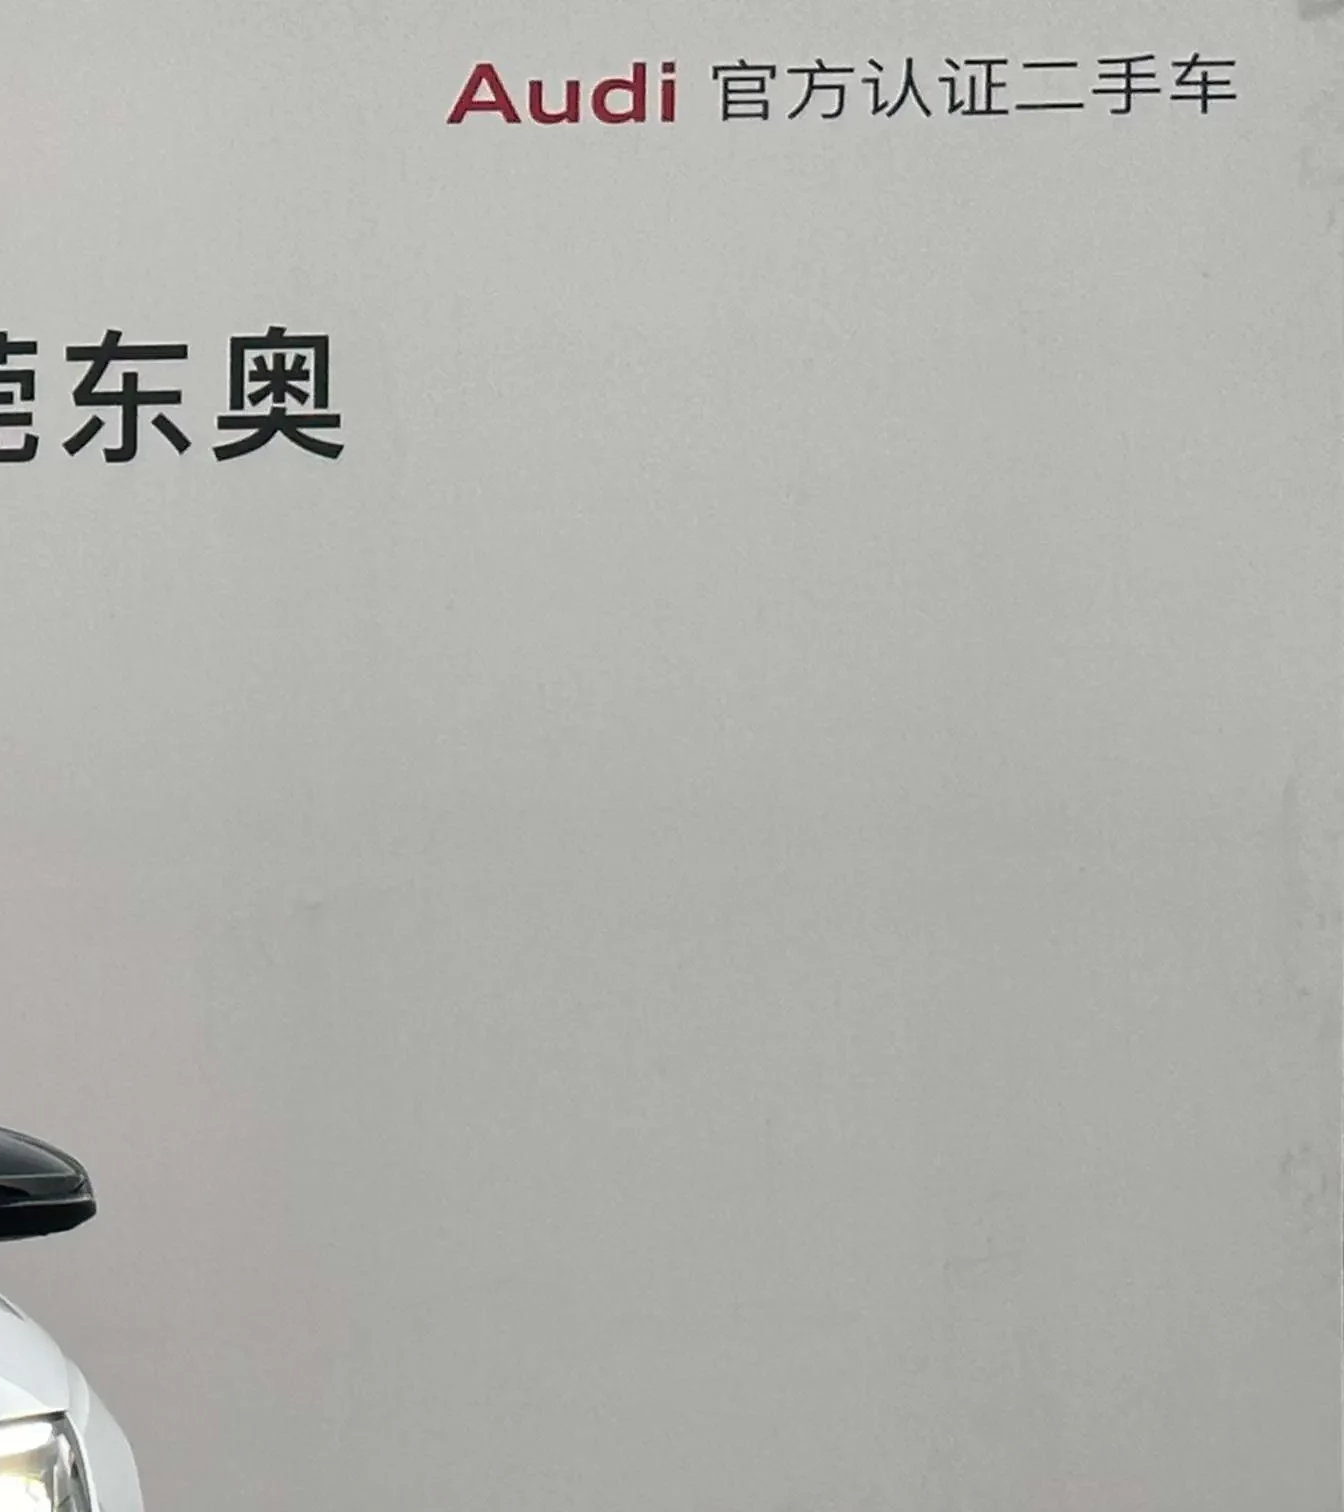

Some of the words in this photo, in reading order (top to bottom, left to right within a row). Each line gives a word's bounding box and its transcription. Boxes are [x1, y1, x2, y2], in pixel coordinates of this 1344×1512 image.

[446, 60, 677, 125] Audi
[711, 52, 1239, 122] 官方认证二手车
